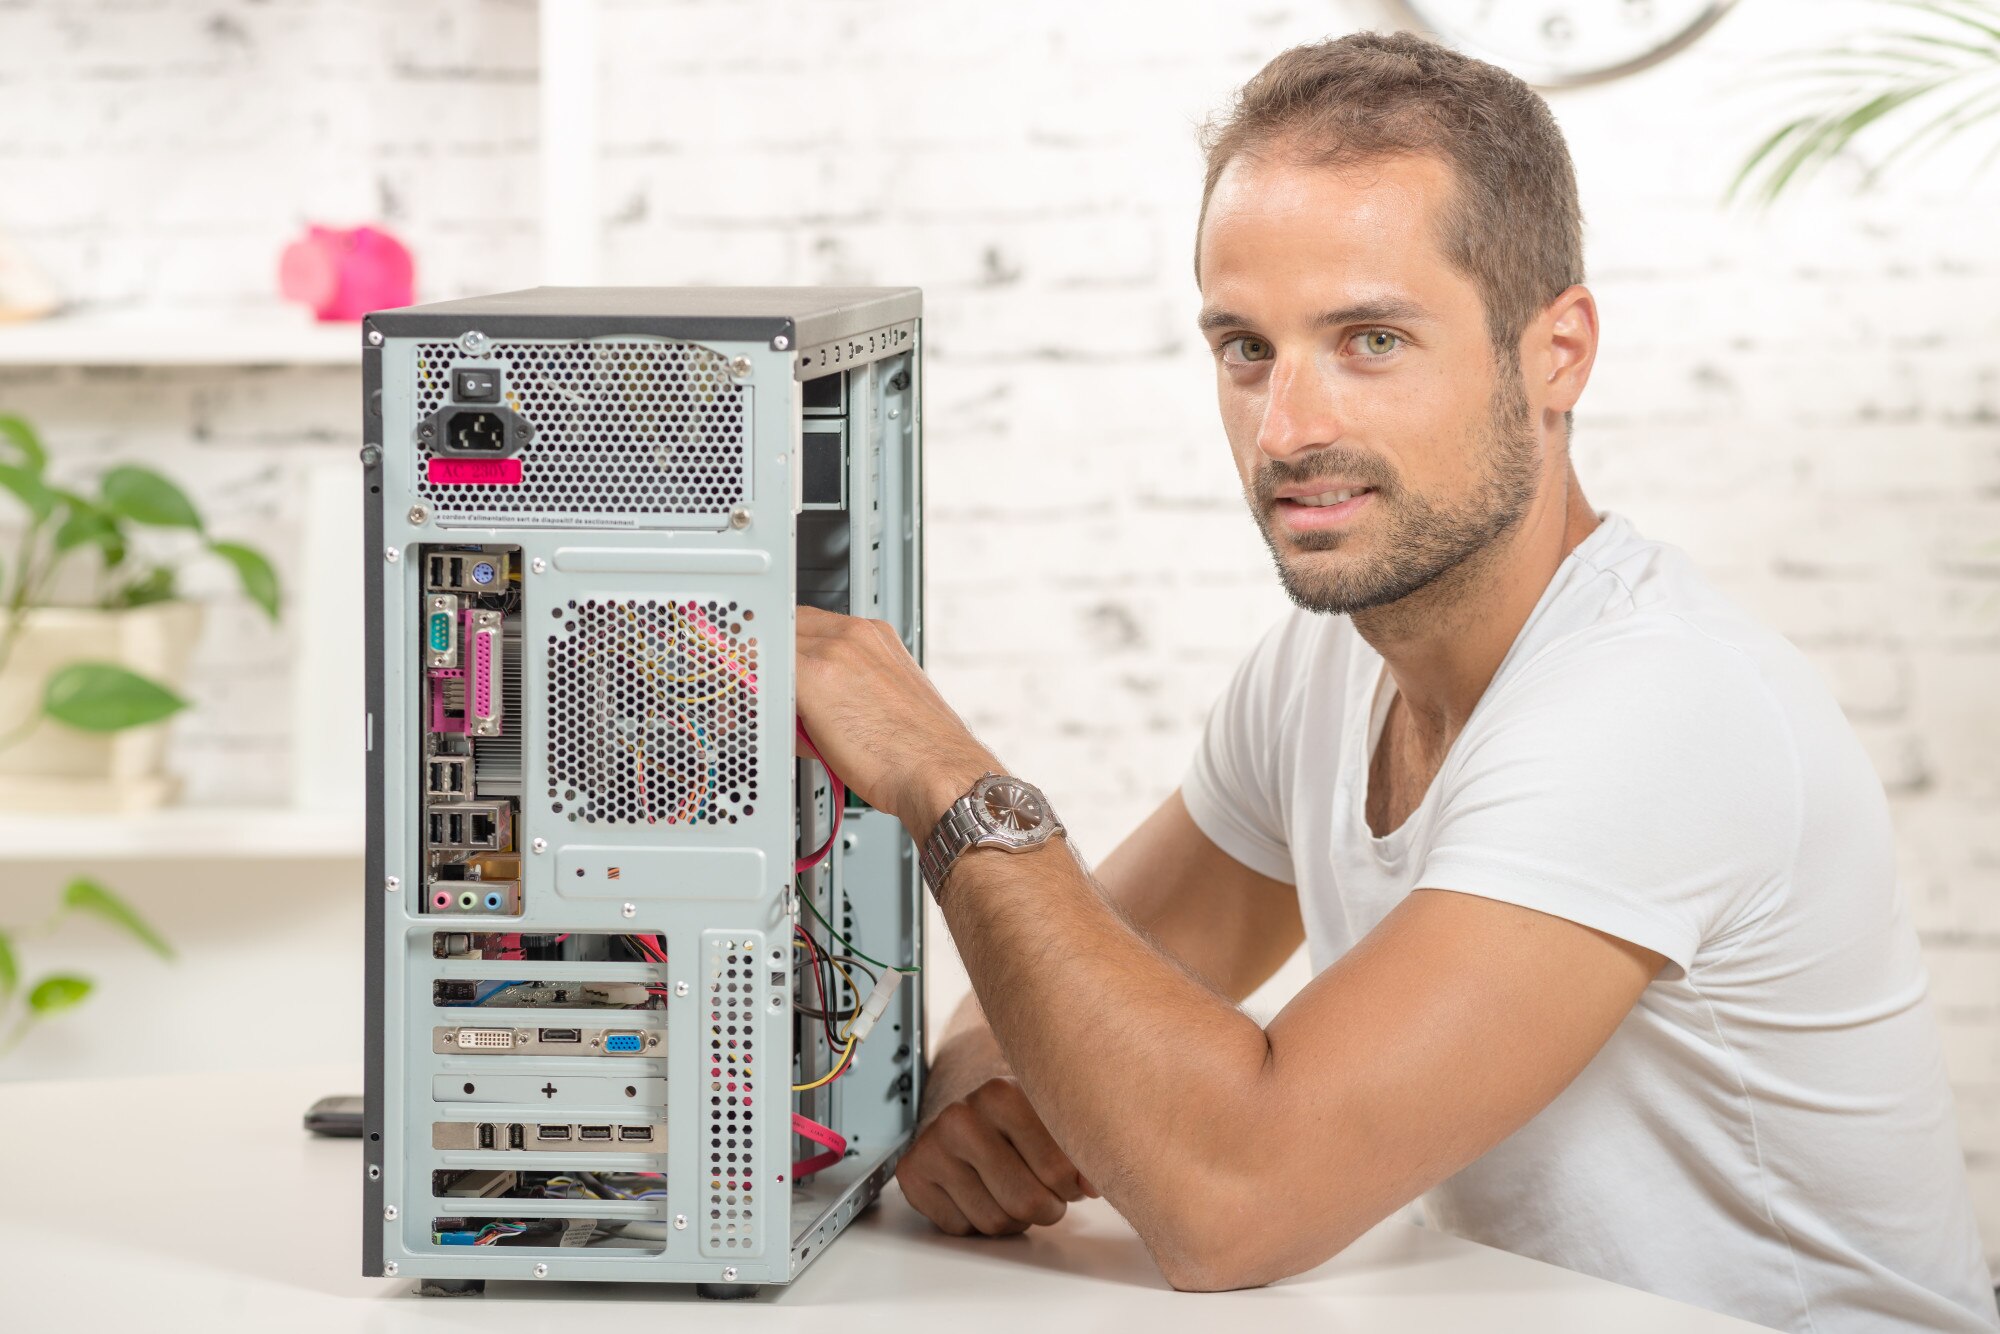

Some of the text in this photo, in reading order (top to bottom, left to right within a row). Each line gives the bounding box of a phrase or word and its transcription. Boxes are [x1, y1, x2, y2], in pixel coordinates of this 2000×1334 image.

[442, 464, 508, 478] AC 230V
[541, 517, 574, 525] dispositif
